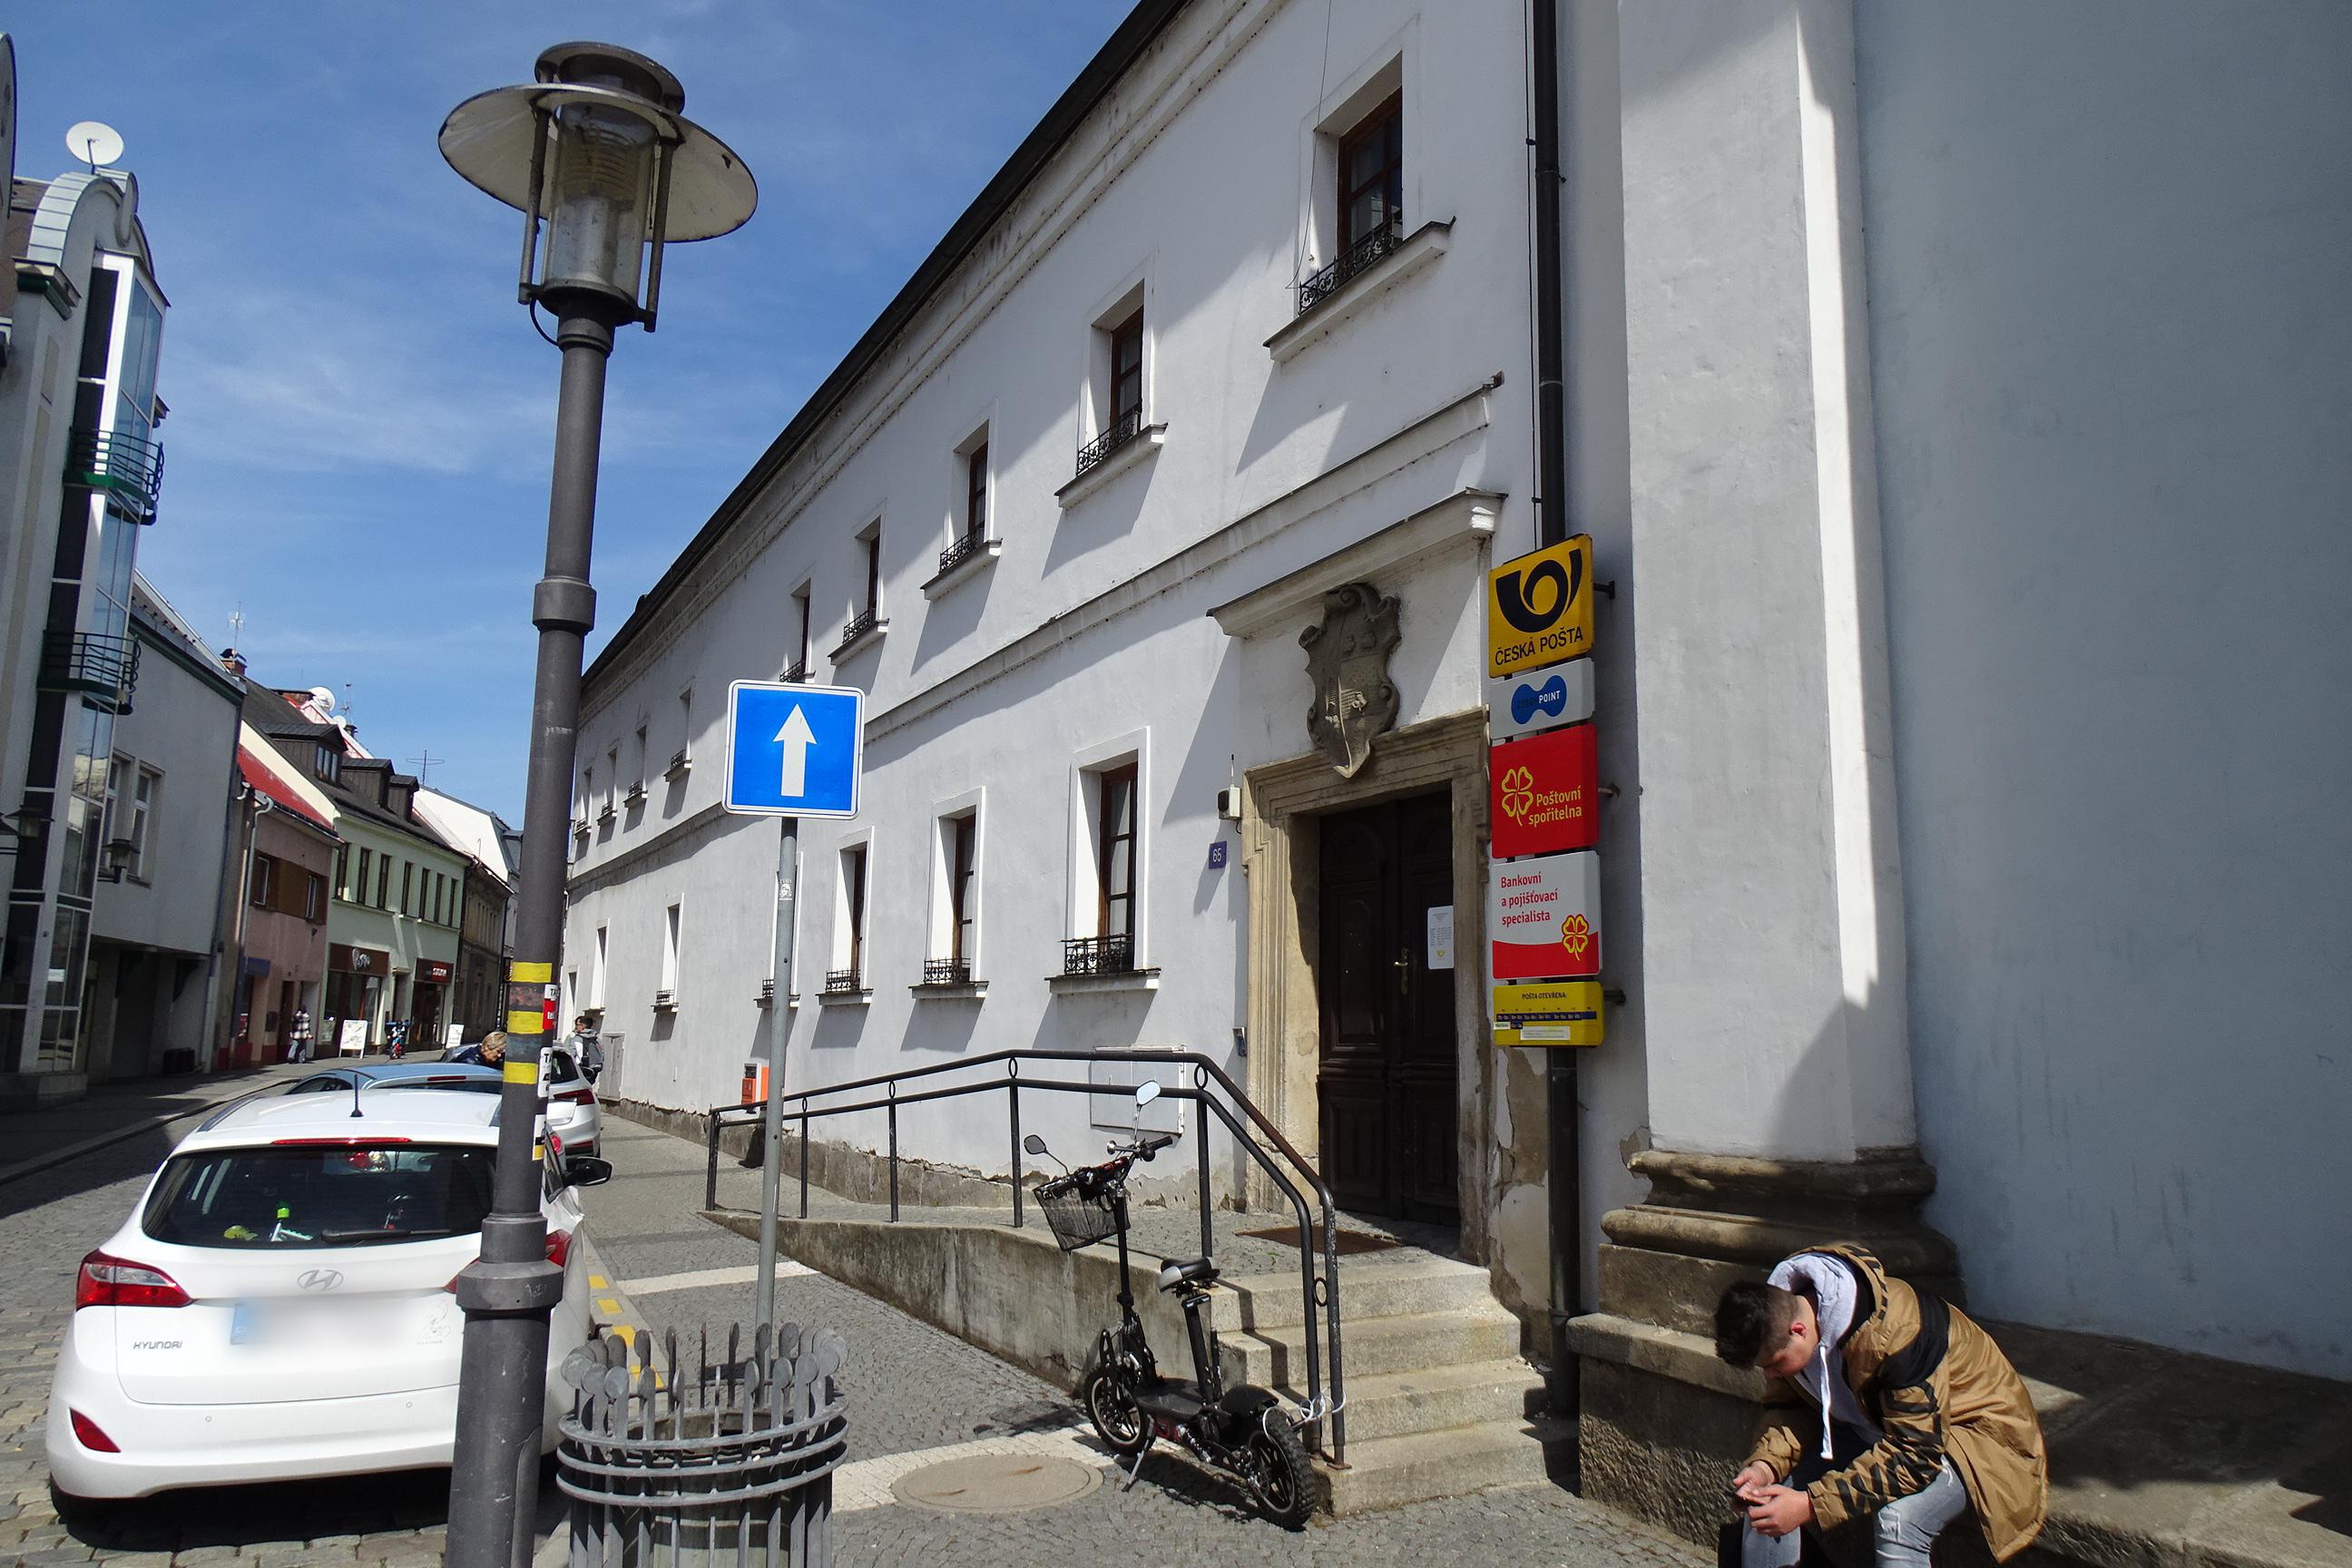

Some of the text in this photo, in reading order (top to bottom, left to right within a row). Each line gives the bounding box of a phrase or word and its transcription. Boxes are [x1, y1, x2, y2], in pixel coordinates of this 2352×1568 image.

[1494, 626, 1583, 665] ČESKÁ POŠTA
[1538, 690, 1561, 704] POINT
[1536, 785, 1581, 807] Poštovní
[1528, 804, 1583, 828] spořitelna
[1501, 871, 1542, 888] Bankovní
[1501, 887, 1559, 908] a pojišťovací
[1502, 910, 1551, 927] specialista
[132, 1340, 183, 1349] HYUNDAI
